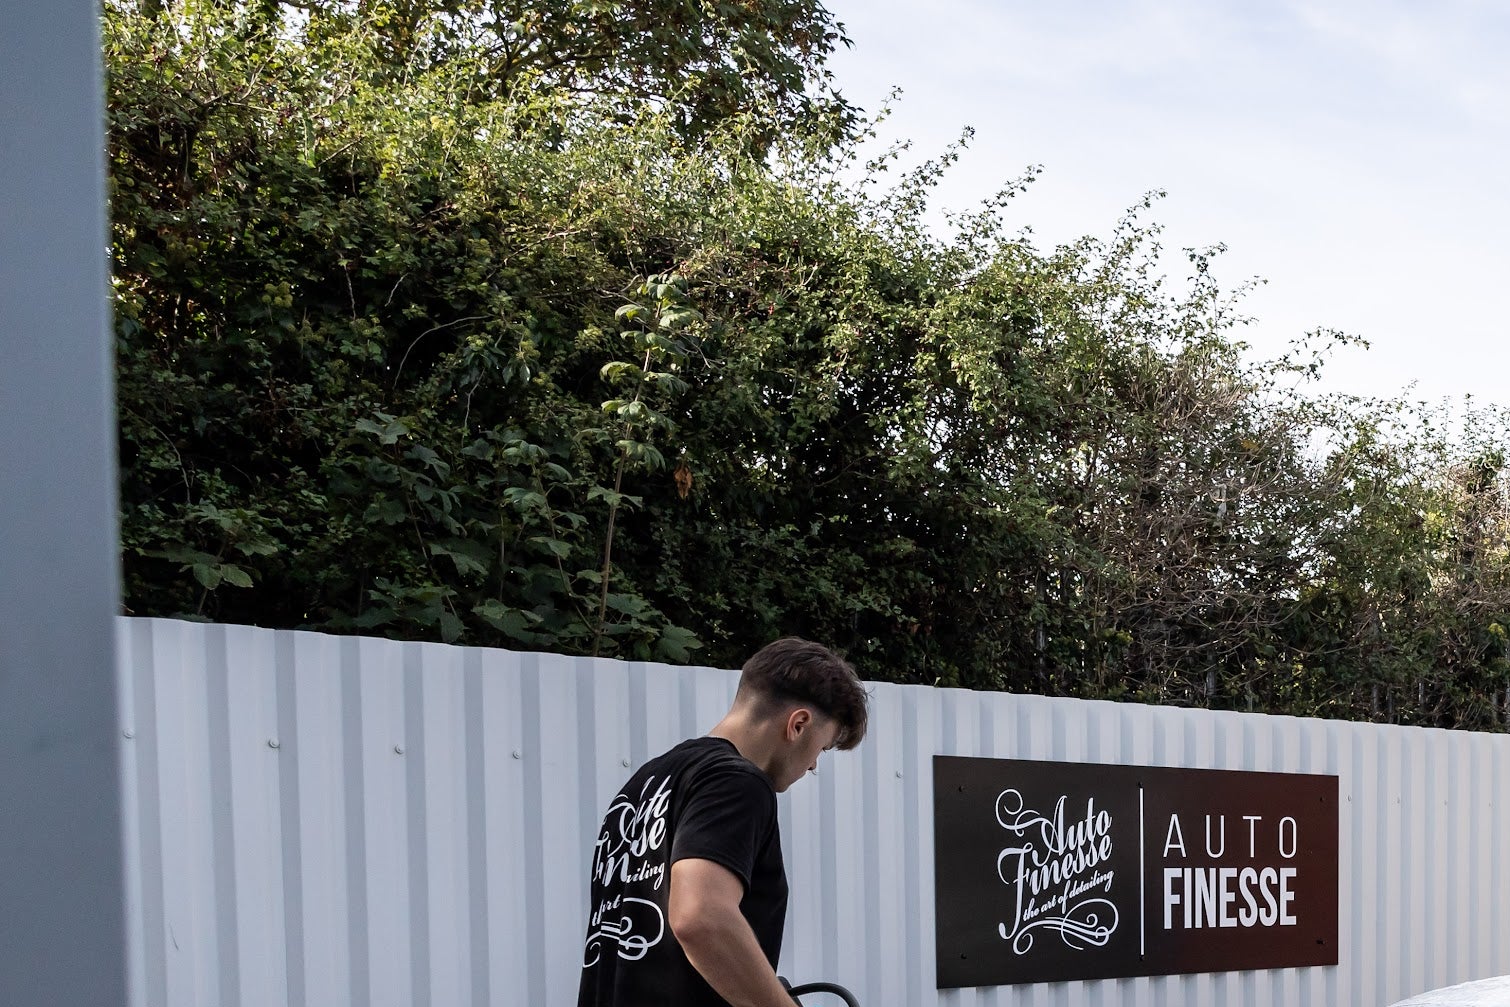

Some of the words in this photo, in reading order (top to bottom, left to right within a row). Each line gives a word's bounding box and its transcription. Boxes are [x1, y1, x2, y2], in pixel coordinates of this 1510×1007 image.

[1003, 791, 1112, 867] Auto
[1163, 813, 1297, 858] AUTO
[998, 835, 1112, 939] Finesse
[1023, 898, 1040, 922] the
[1040, 895, 1057, 913] art
[1058, 880, 1071, 914] of
[1069, 870, 1114, 898] detailing
[1163, 867, 1297, 929] FINESSE
